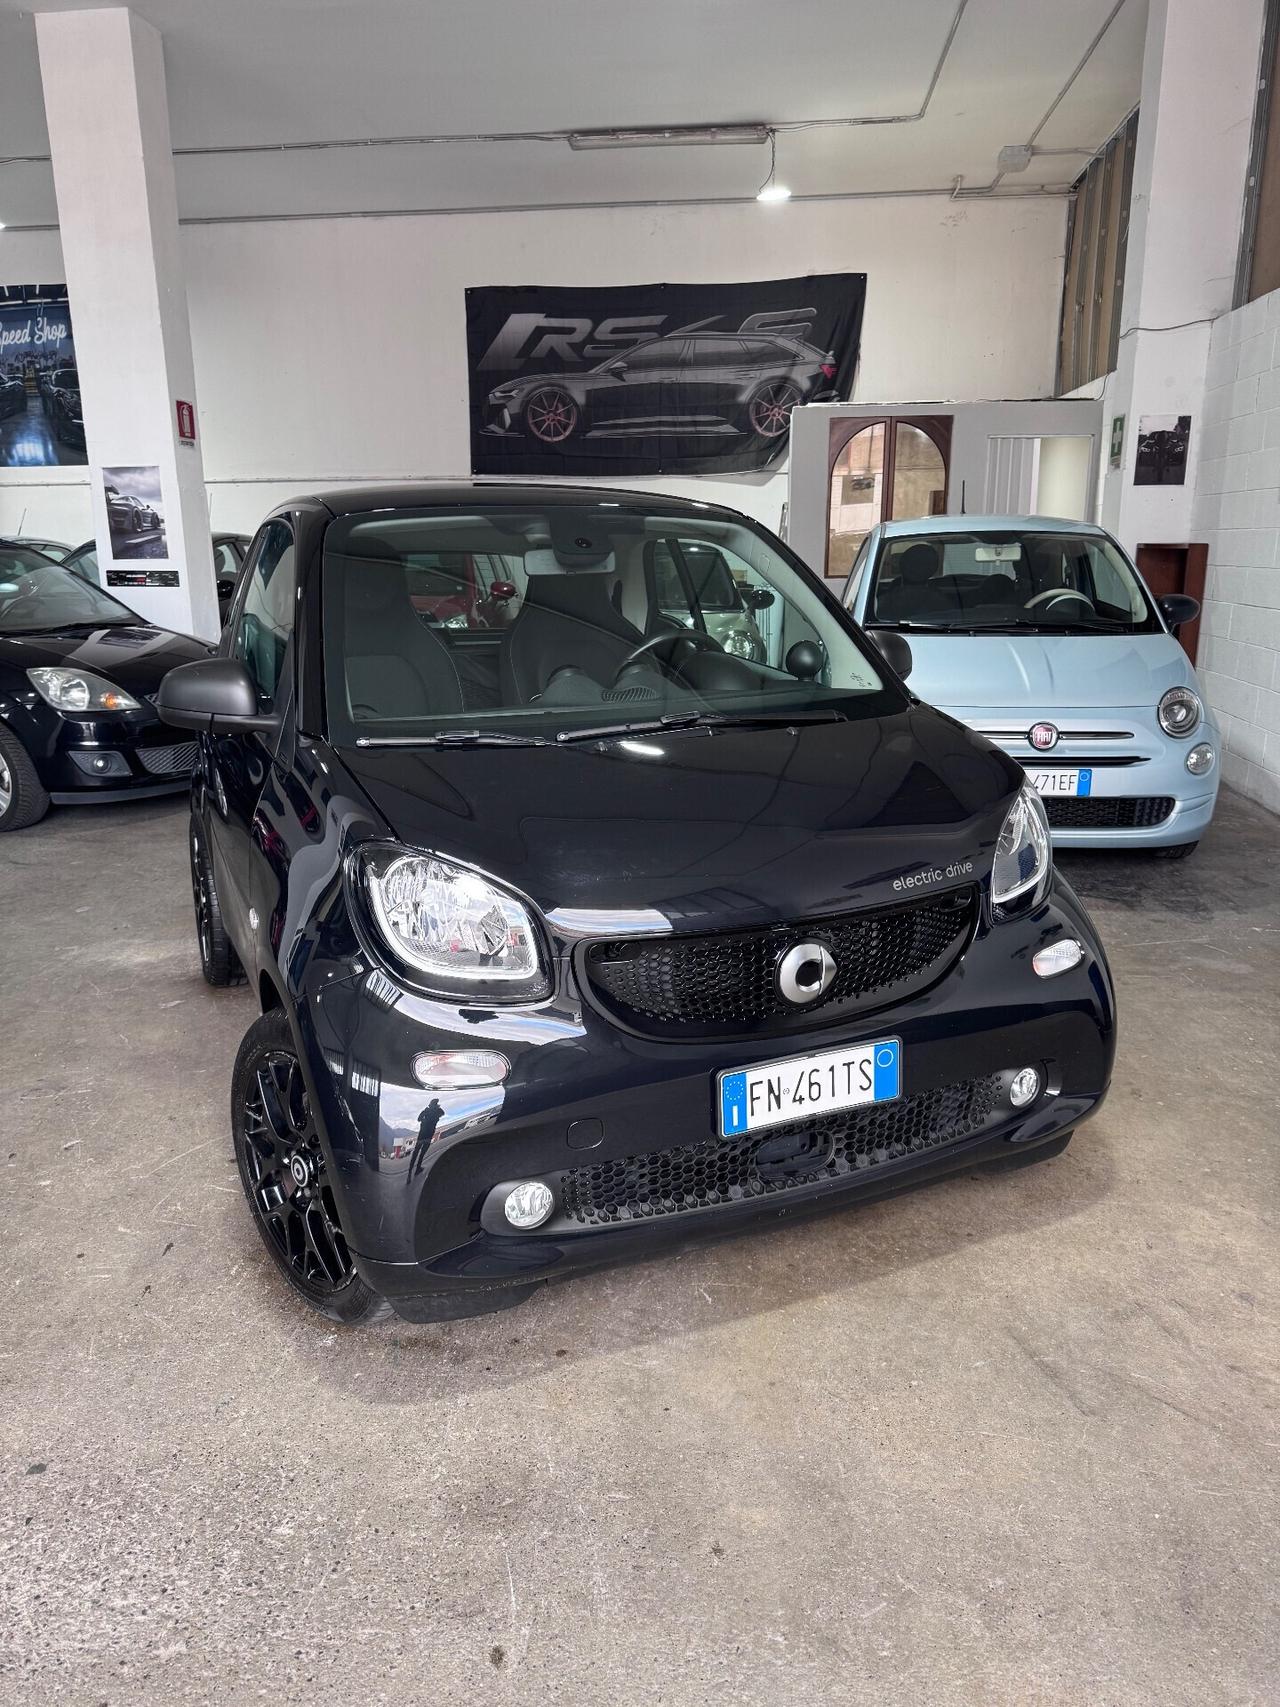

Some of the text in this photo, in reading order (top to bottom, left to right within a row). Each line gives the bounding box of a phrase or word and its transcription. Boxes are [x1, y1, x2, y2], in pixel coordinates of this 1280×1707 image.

[34, 316, 67, 349] Shop
[893, 861, 973, 891] electric drive
